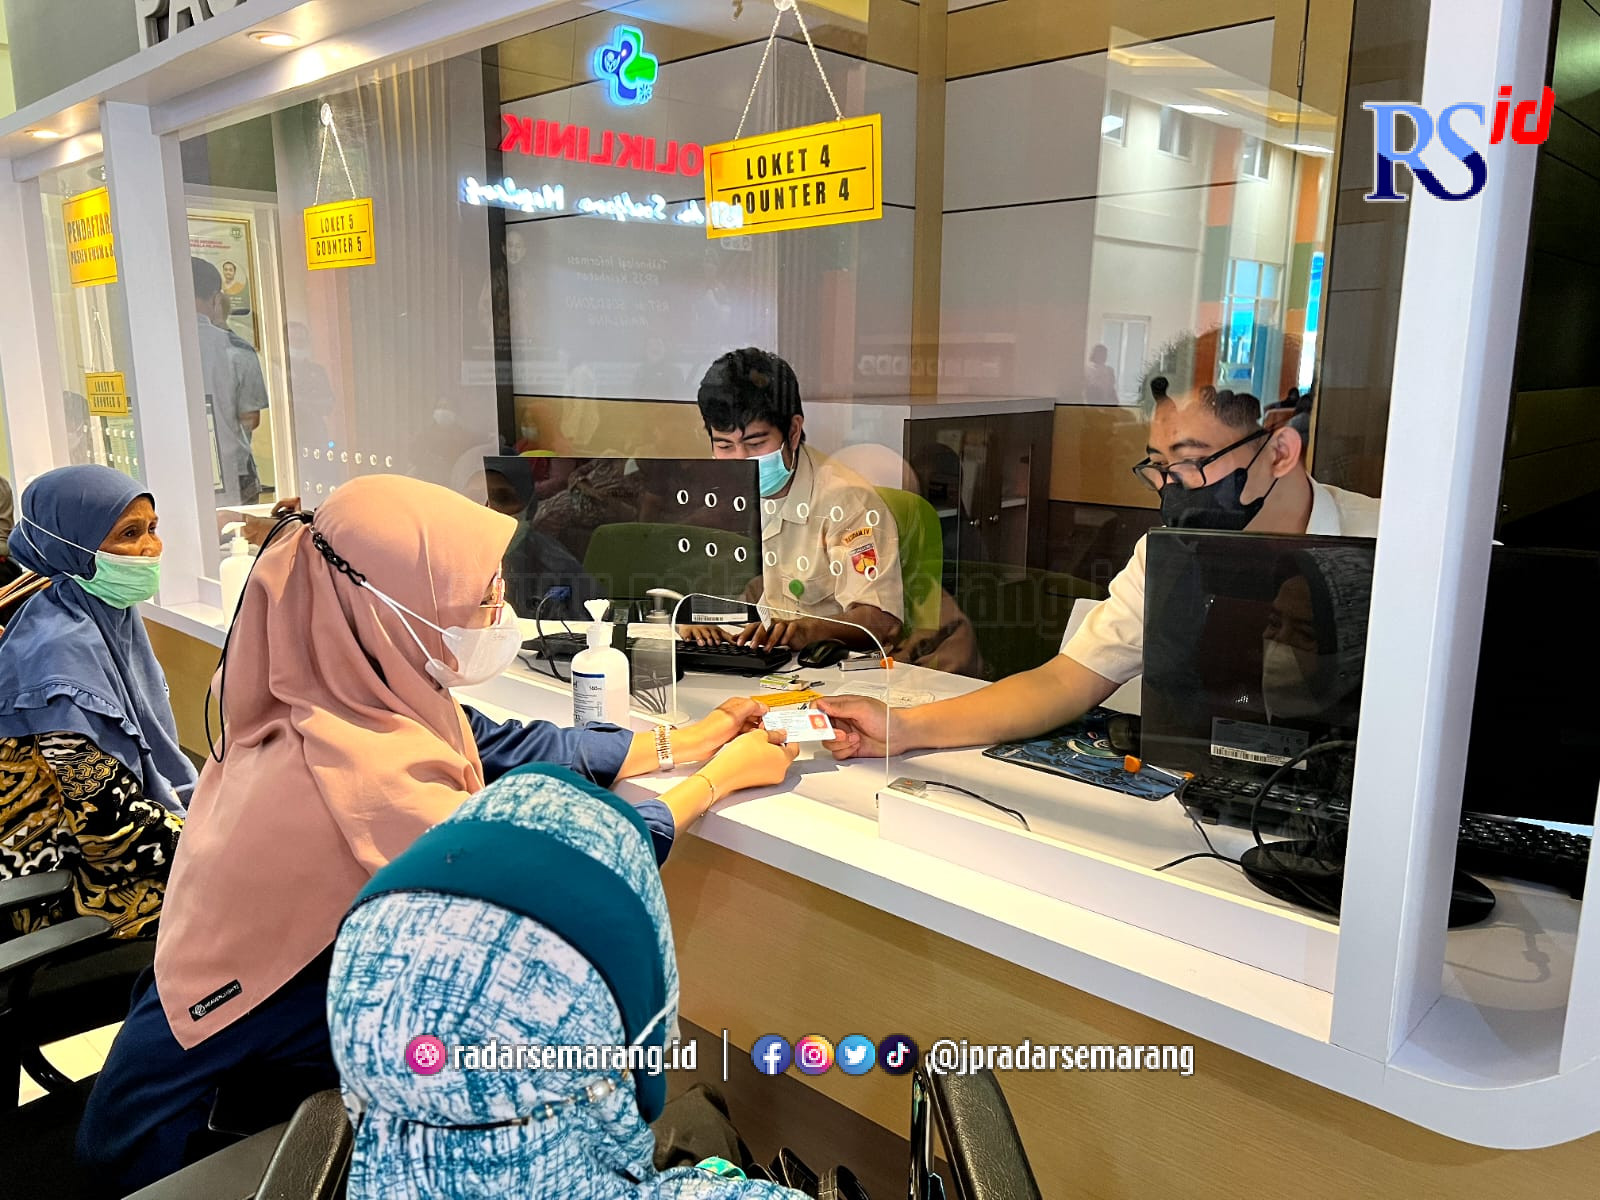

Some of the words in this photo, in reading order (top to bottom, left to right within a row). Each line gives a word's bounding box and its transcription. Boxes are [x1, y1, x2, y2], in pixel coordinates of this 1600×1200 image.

[746, 148, 808, 180] LOKET
[820, 144, 831, 168] 4
[838, 177, 850, 201] 4
[320, 216, 345, 233] LOKET
[348, 214, 354, 230] 5
[316, 238, 353, 256] COUNTER
[357, 236, 362, 252] 5
